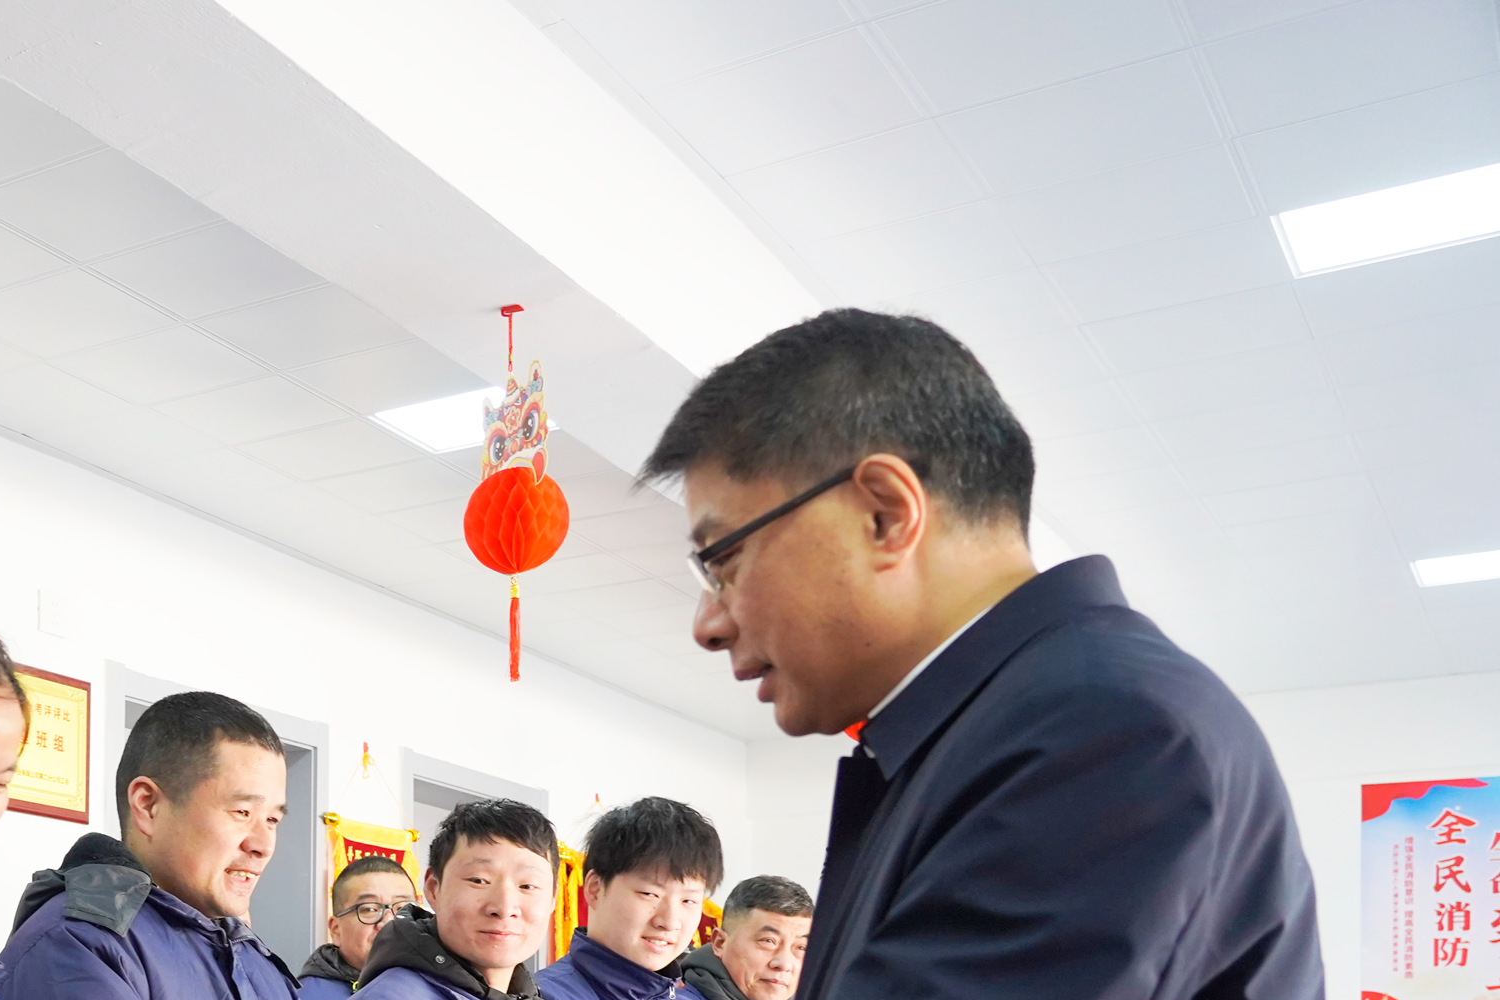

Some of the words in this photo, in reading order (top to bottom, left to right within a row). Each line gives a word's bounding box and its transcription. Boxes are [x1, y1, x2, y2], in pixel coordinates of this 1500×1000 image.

[29, 702, 70, 722] 考评评比
[1429, 809, 1477, 967] 全民消防
